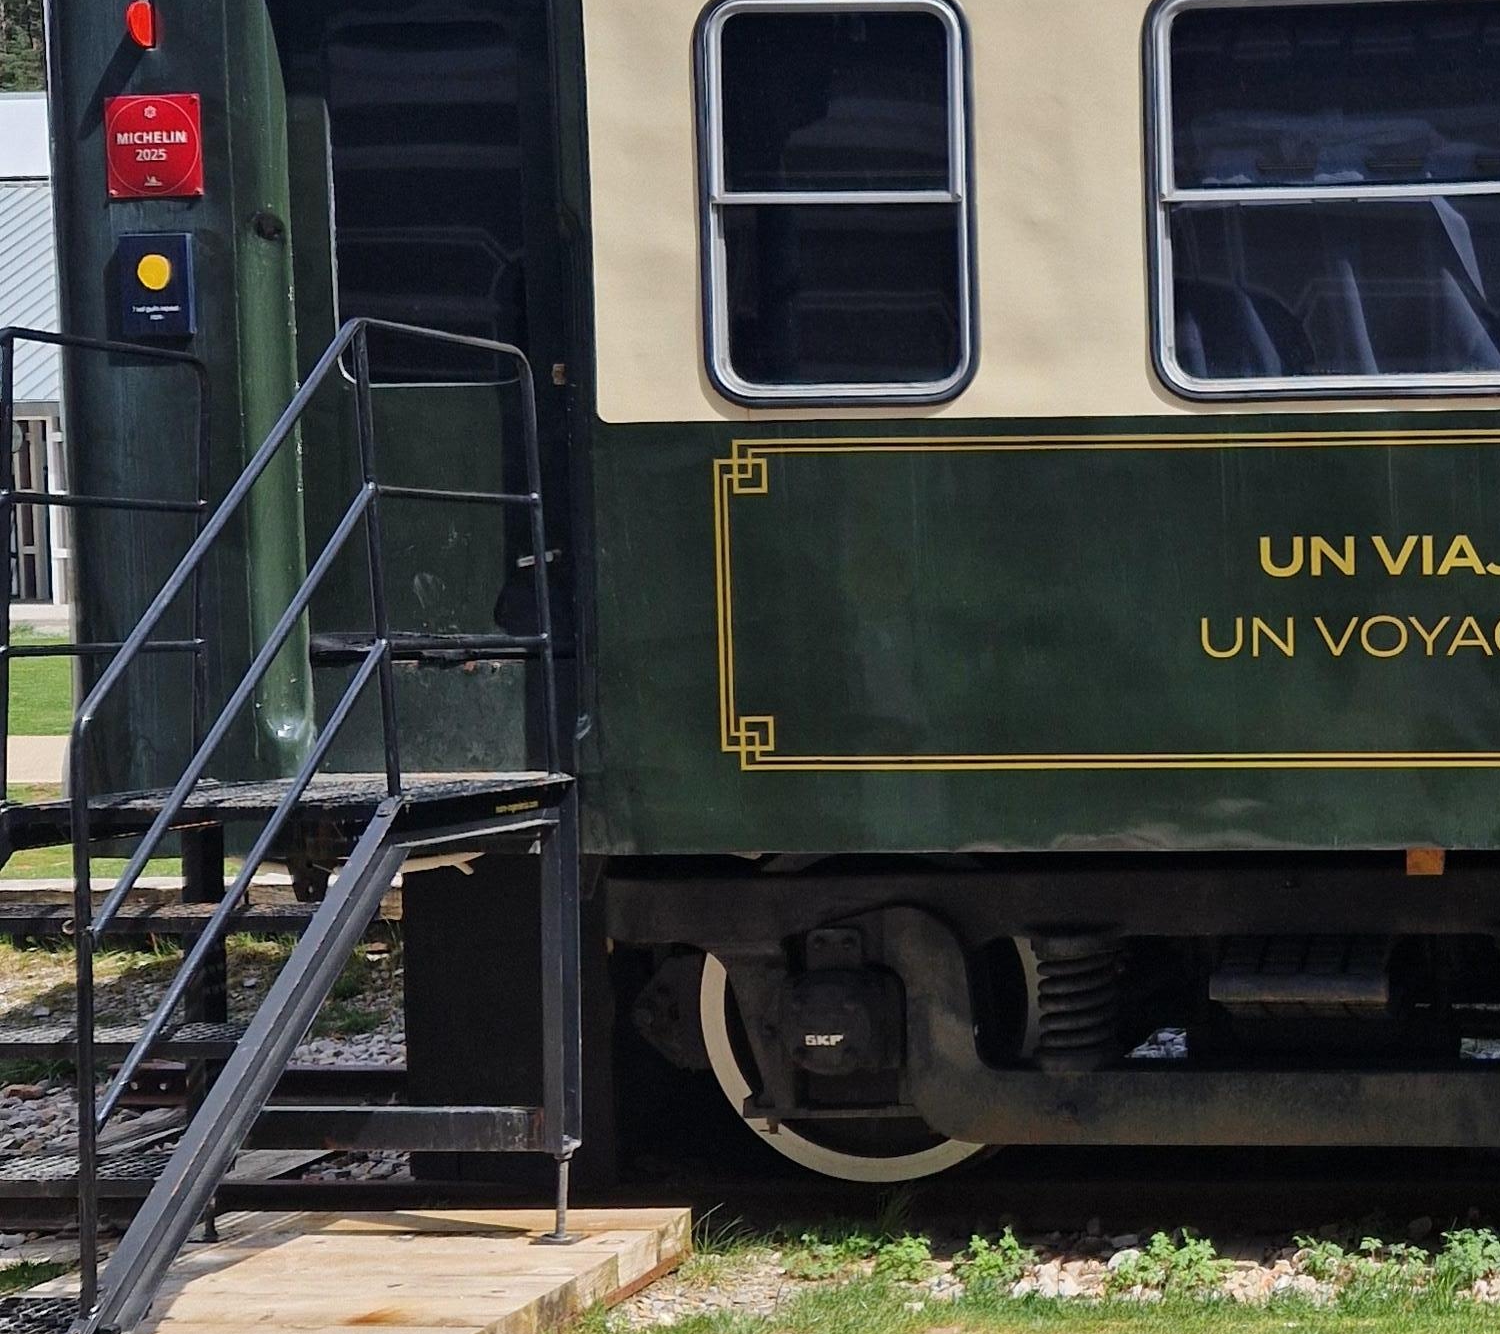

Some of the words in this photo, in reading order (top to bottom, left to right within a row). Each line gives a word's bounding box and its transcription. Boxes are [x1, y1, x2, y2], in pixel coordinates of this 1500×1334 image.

[116, 130, 188, 145] MICHELIN
[135, 148, 167, 161] 2025
[1259, 535, 1356, 578] UN
[1200, 616, 1296, 659] UN
[805, 1034, 844, 1046] SKF
